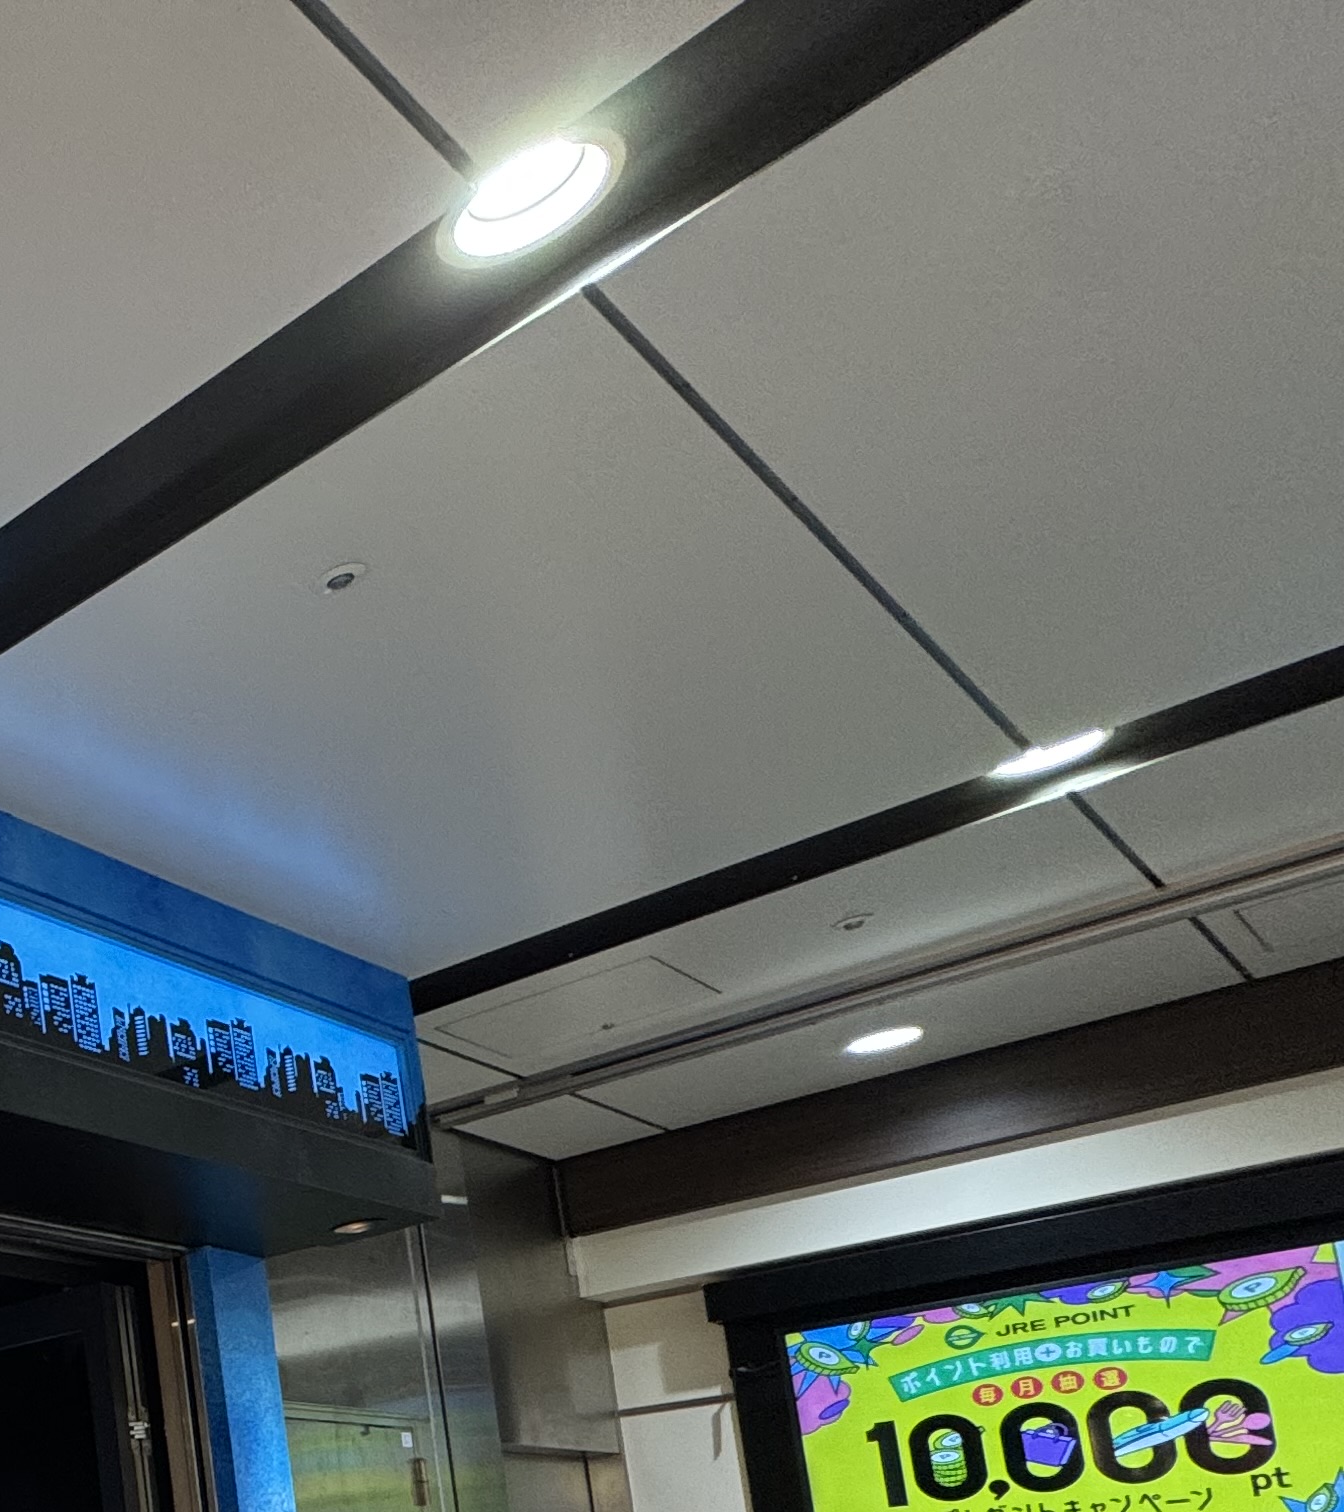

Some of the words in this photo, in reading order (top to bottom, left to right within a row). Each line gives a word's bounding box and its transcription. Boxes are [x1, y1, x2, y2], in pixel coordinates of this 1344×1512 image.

[995, 1320, 1046, 1337] JRE
[1054, 1305, 1136, 1328] POINT
[866, 1379, 1275, 1507] 10,000
[1250, 1467, 1293, 1497] pt
